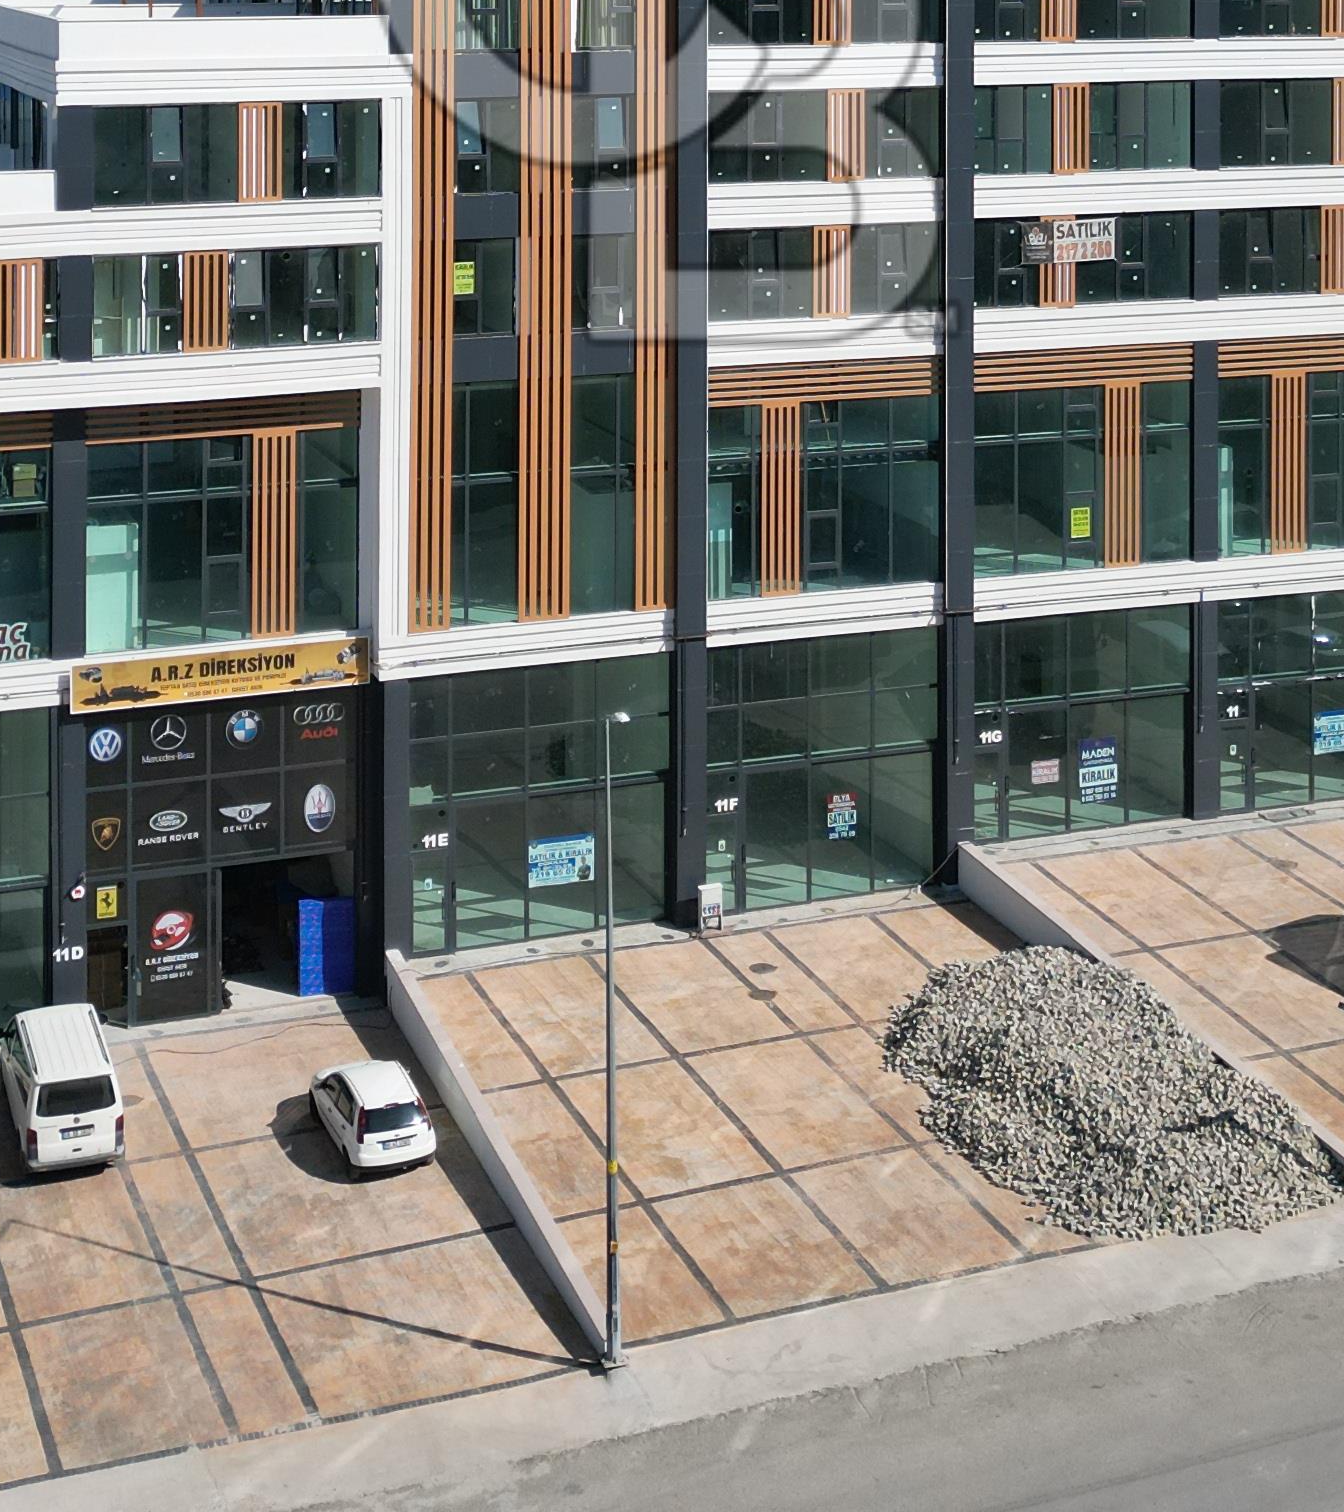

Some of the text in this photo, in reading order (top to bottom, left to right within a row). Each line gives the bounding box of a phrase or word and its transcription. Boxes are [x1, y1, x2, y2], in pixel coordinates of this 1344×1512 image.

[1056, 220, 1113, 240] SATILIK
[150, 652, 296, 683] A.R.Z DİREKSİYON
[301, 726, 339, 740] Audi
[979, 730, 1003, 745] 11G
[1081, 746, 1115, 761] MADEN
[714, 797, 739, 813] 11F
[222, 822, 268, 834] BENTLEY
[169, 831, 199, 842] ROVER
[422, 833, 449, 848] 11E
[53, 946, 84, 962] 11D
